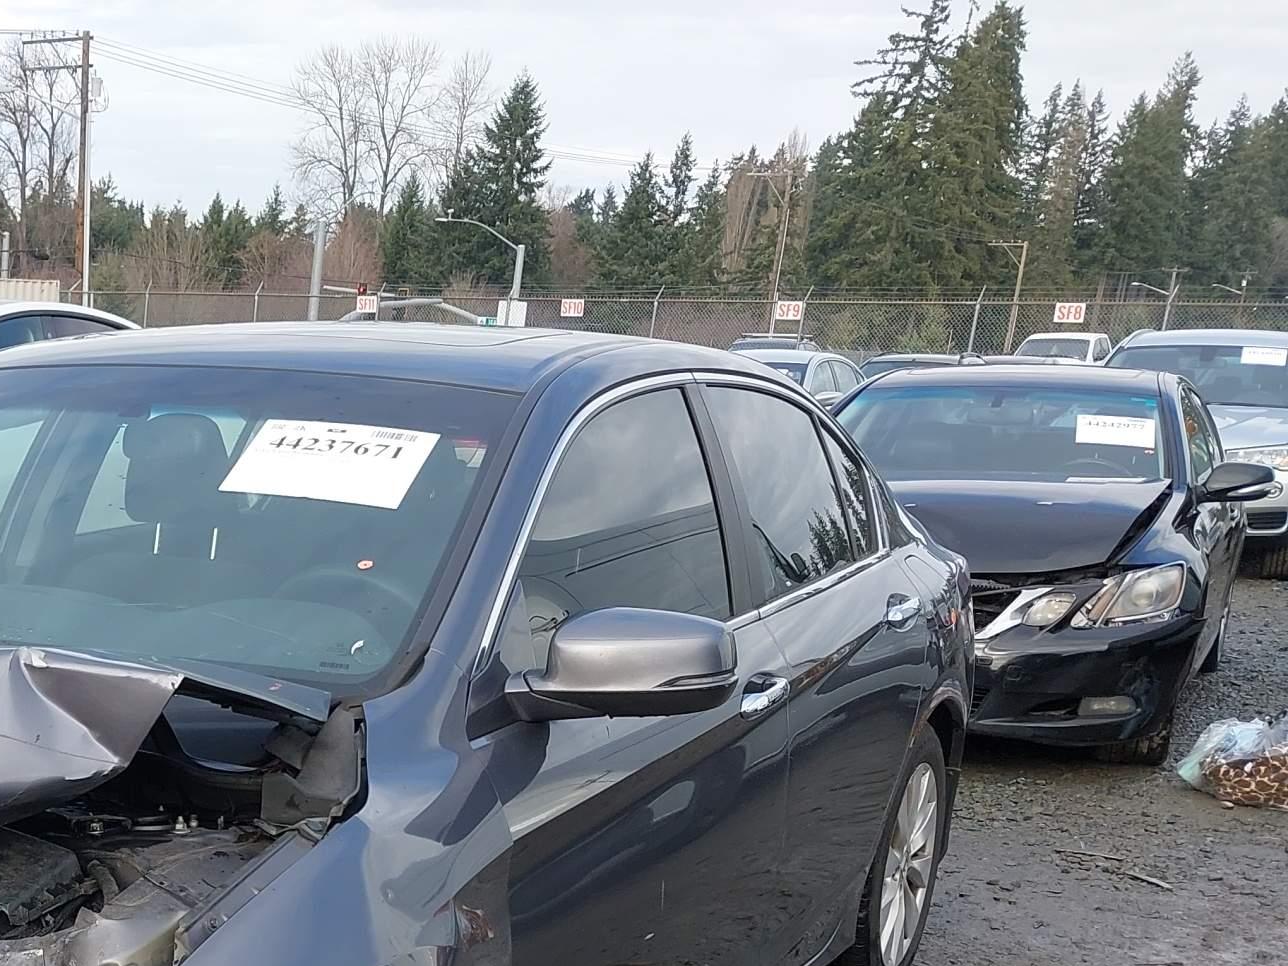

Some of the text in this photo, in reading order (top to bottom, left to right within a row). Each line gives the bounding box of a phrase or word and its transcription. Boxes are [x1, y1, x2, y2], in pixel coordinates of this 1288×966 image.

[358, 298, 375, 311] SF11
[562, 301, 583, 315] SF10
[778, 303, 800, 318] SF9
[1057, 305, 1082, 320] SF8
[268, 434, 405, 460] 44237671
